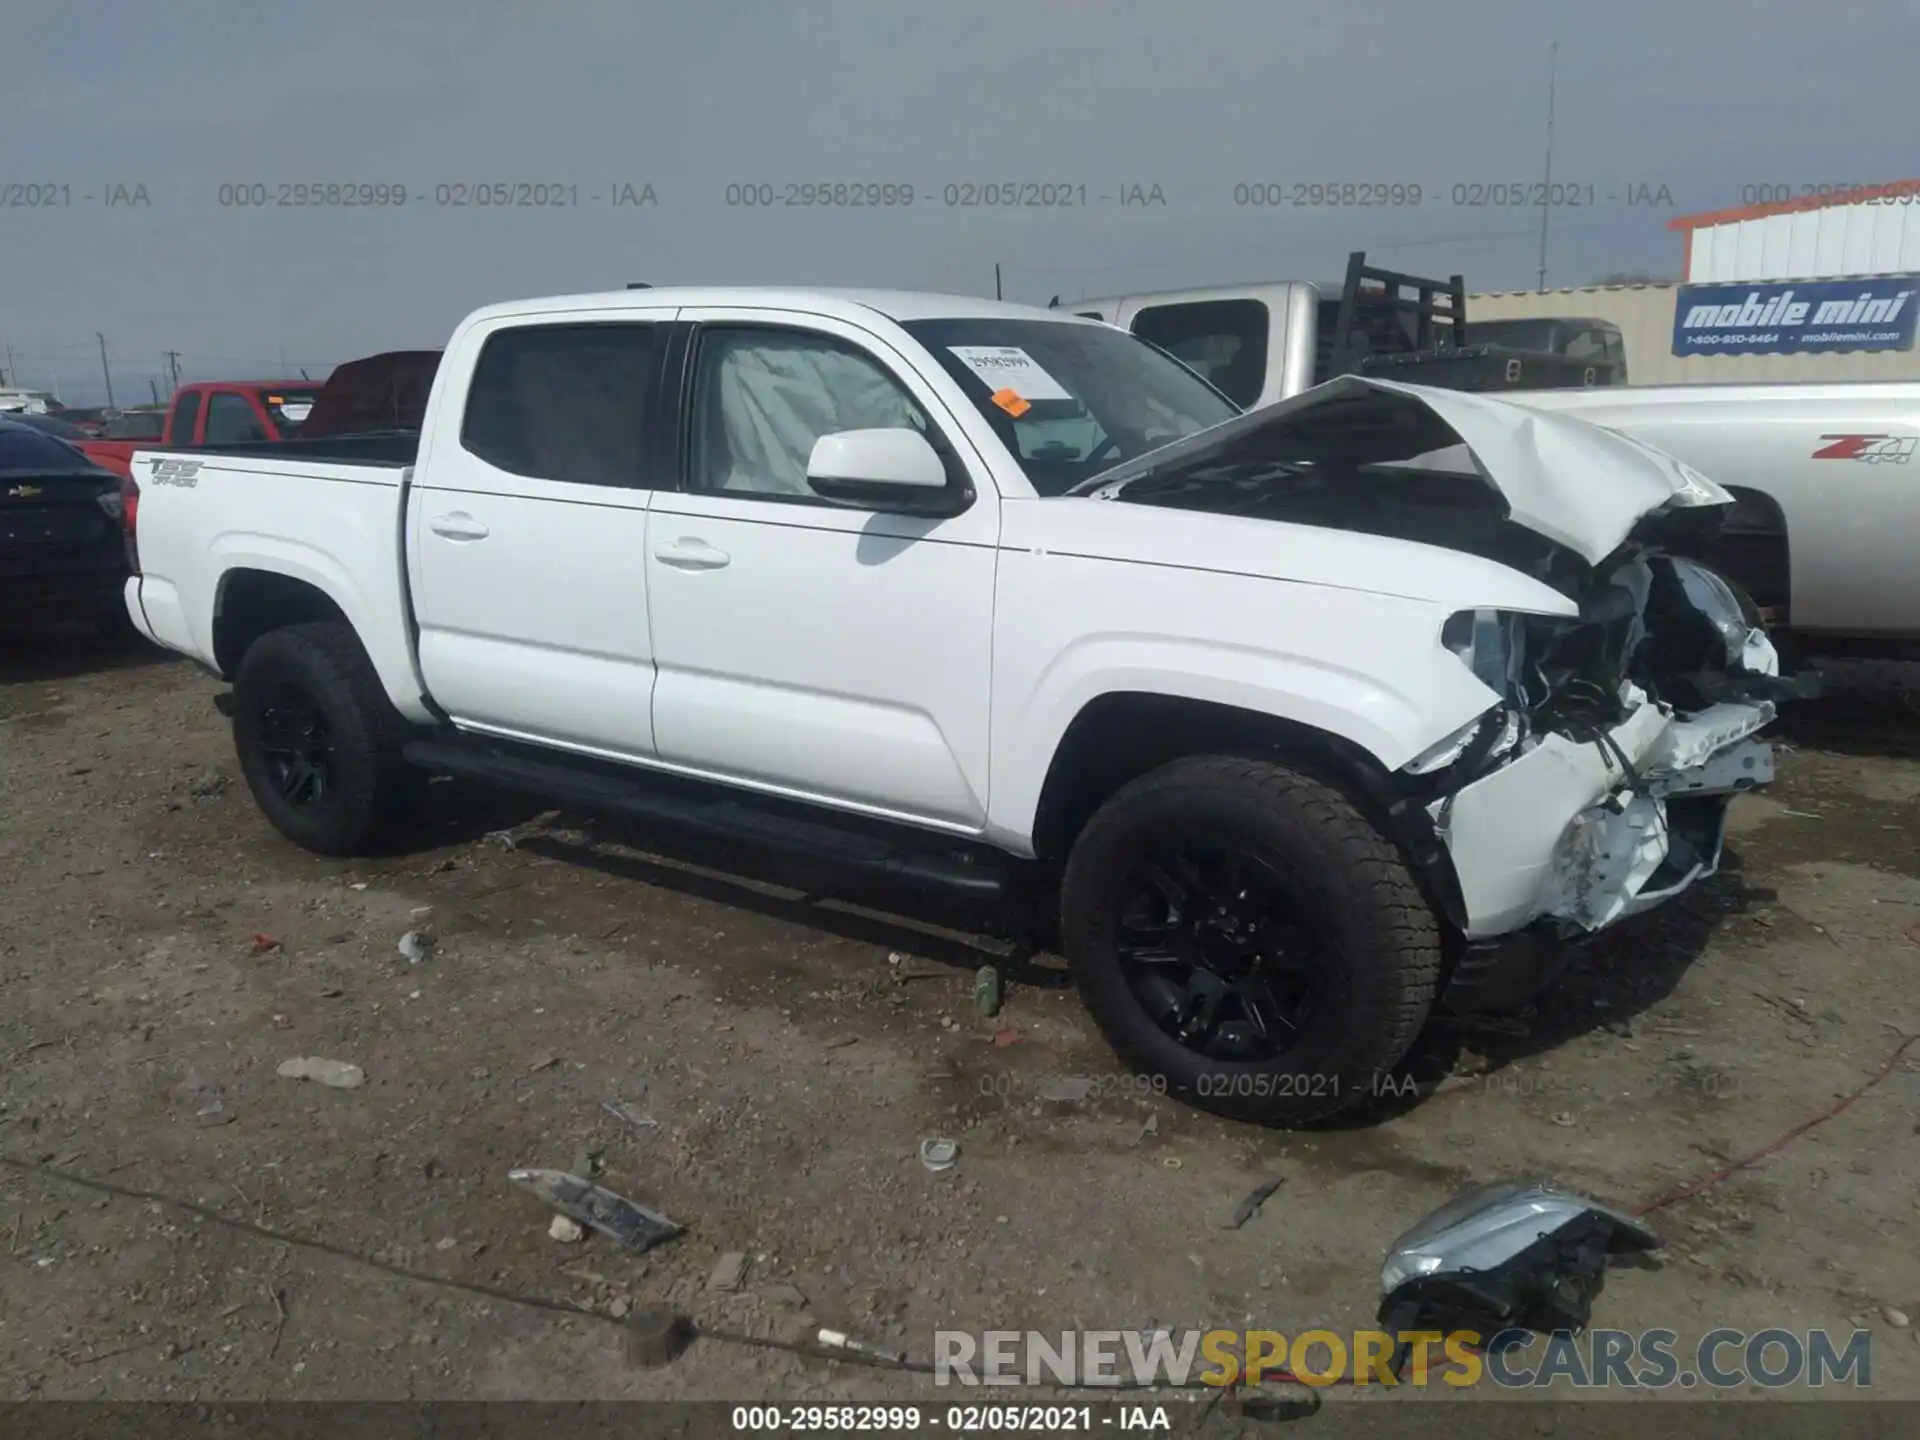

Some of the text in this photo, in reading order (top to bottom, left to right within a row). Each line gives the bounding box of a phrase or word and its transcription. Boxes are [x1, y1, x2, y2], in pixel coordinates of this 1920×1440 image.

[1683, 291, 1908, 328] mobile mini
[1801, 331, 1900, 343] mobilemini.com
